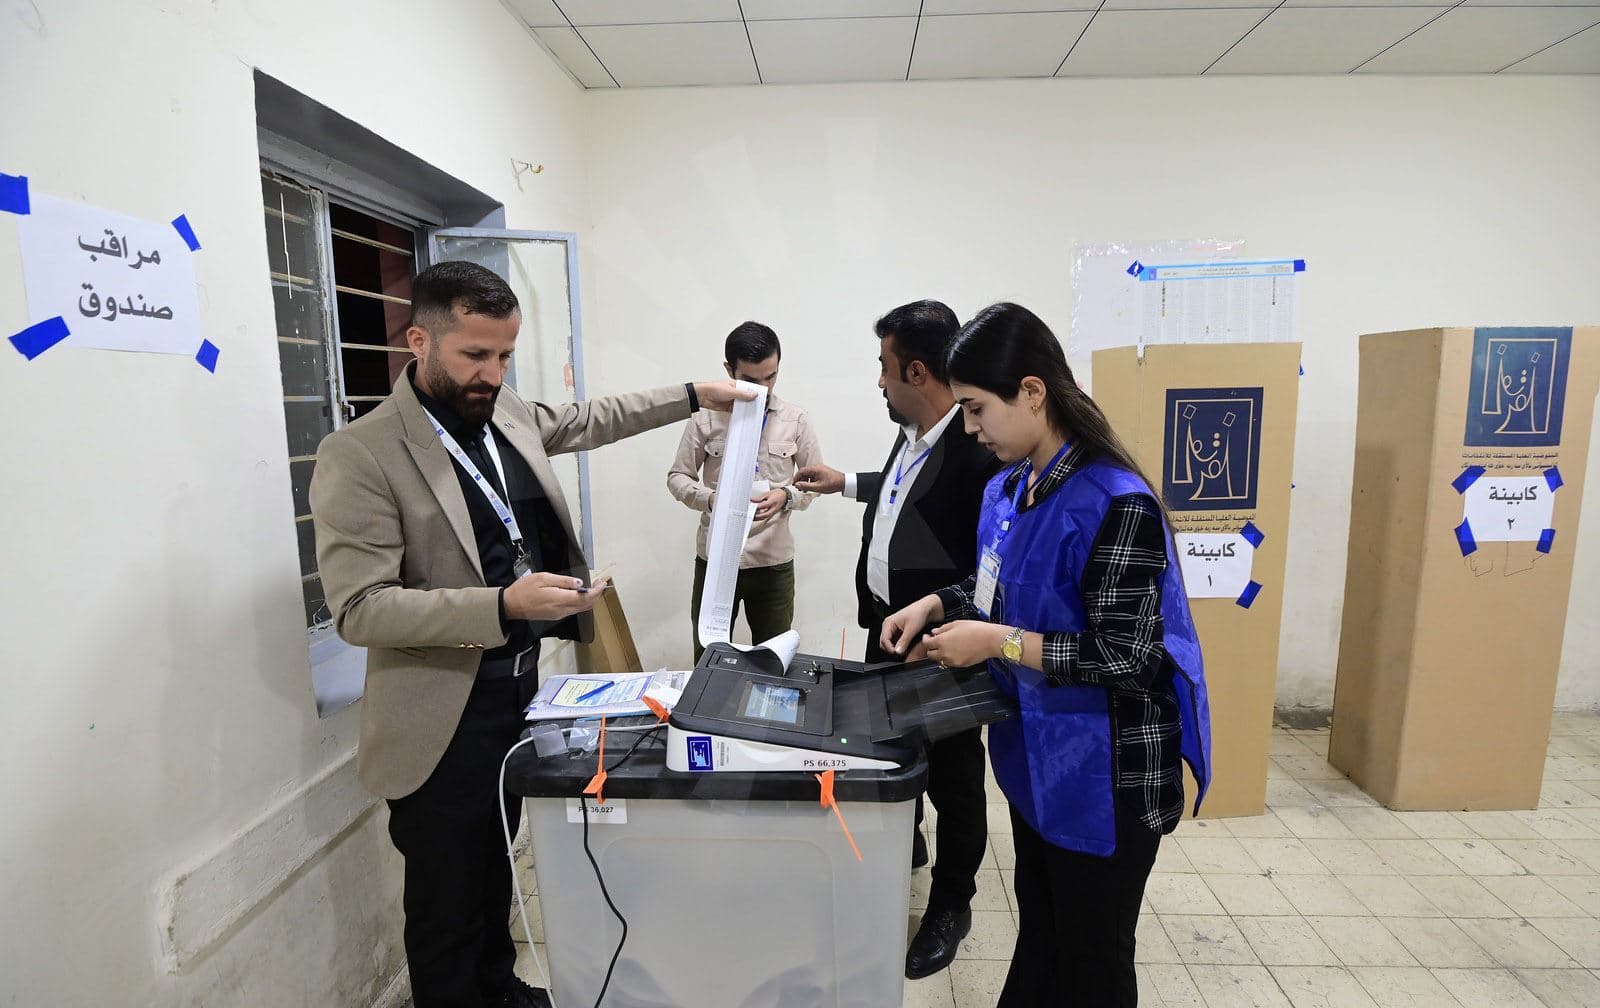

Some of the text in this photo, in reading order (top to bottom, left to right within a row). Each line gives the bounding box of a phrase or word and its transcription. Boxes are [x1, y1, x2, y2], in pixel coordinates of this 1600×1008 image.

[78, 228, 161, 269] مراقب
[79, 283, 173, 321] صندوق
[1489, 485, 1538, 505] كابينة
[1507, 518, 1515, 530] ٢
[1187, 542, 1236, 561] كابينة
[1207, 574, 1212, 587] ١
[803, 759, 847, 768] PS 66,375
[591, 806, 614, 814] 36,027
